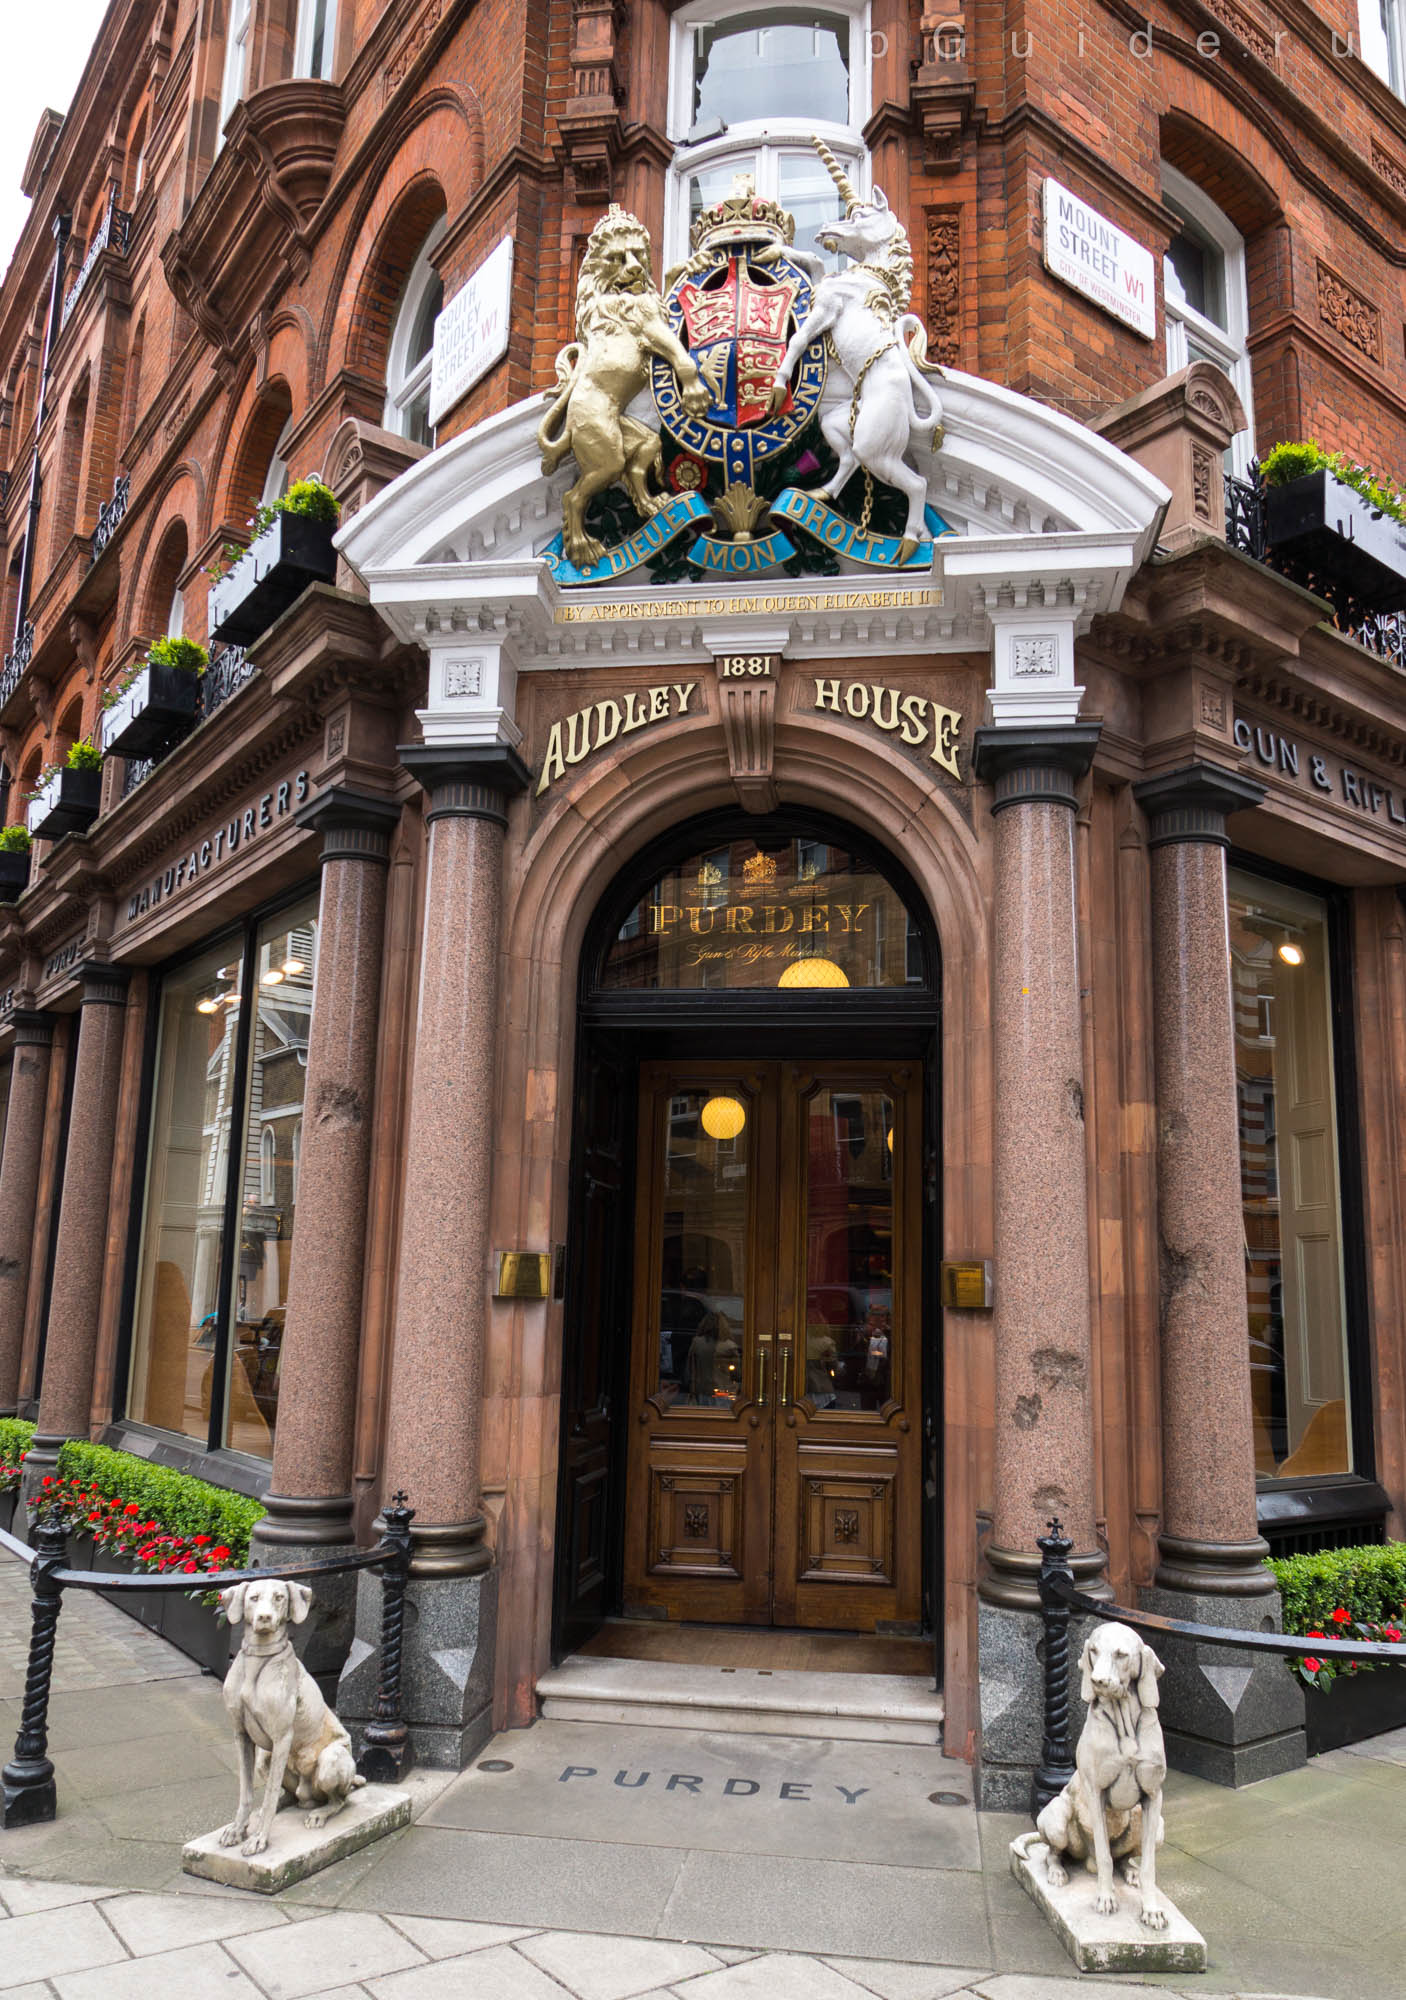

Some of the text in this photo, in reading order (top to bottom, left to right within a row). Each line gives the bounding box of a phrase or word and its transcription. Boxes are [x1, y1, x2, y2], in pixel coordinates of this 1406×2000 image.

[1058, 195, 1120, 257] MOUNT
[1059, 224, 1144, 304] STREET W1
[1059, 259, 1077, 278] CITY
[1090, 278, 1142, 325] WESTMINSTER
[439, 300, 481, 364] AUDLEY
[440, 282, 477, 340] SOUTH
[436, 307, 498, 391] STREET W1
[702, 540, 777, 572] MON
[564, 606, 585, 621] BY
[589, 600, 700, 621] APPOINTMENT
[704, 599, 725, 614] TO
[763, 595, 819, 615] QUEEN
[823, 590, 913, 610] ELIZABETH
[918, 590, 931, 605] II
[722, 657, 771, 676] 1881
[535, 678, 963, 798] AUDLEY HOUSE
[1234, 718, 1299, 776] GUN
[1312, 755, 1332, 792] &
[127, 770, 308, 921] MANUFACTURERS
[648, 904, 870, 935] PURDEY
[558, 1765, 871, 1805] PURDEY
